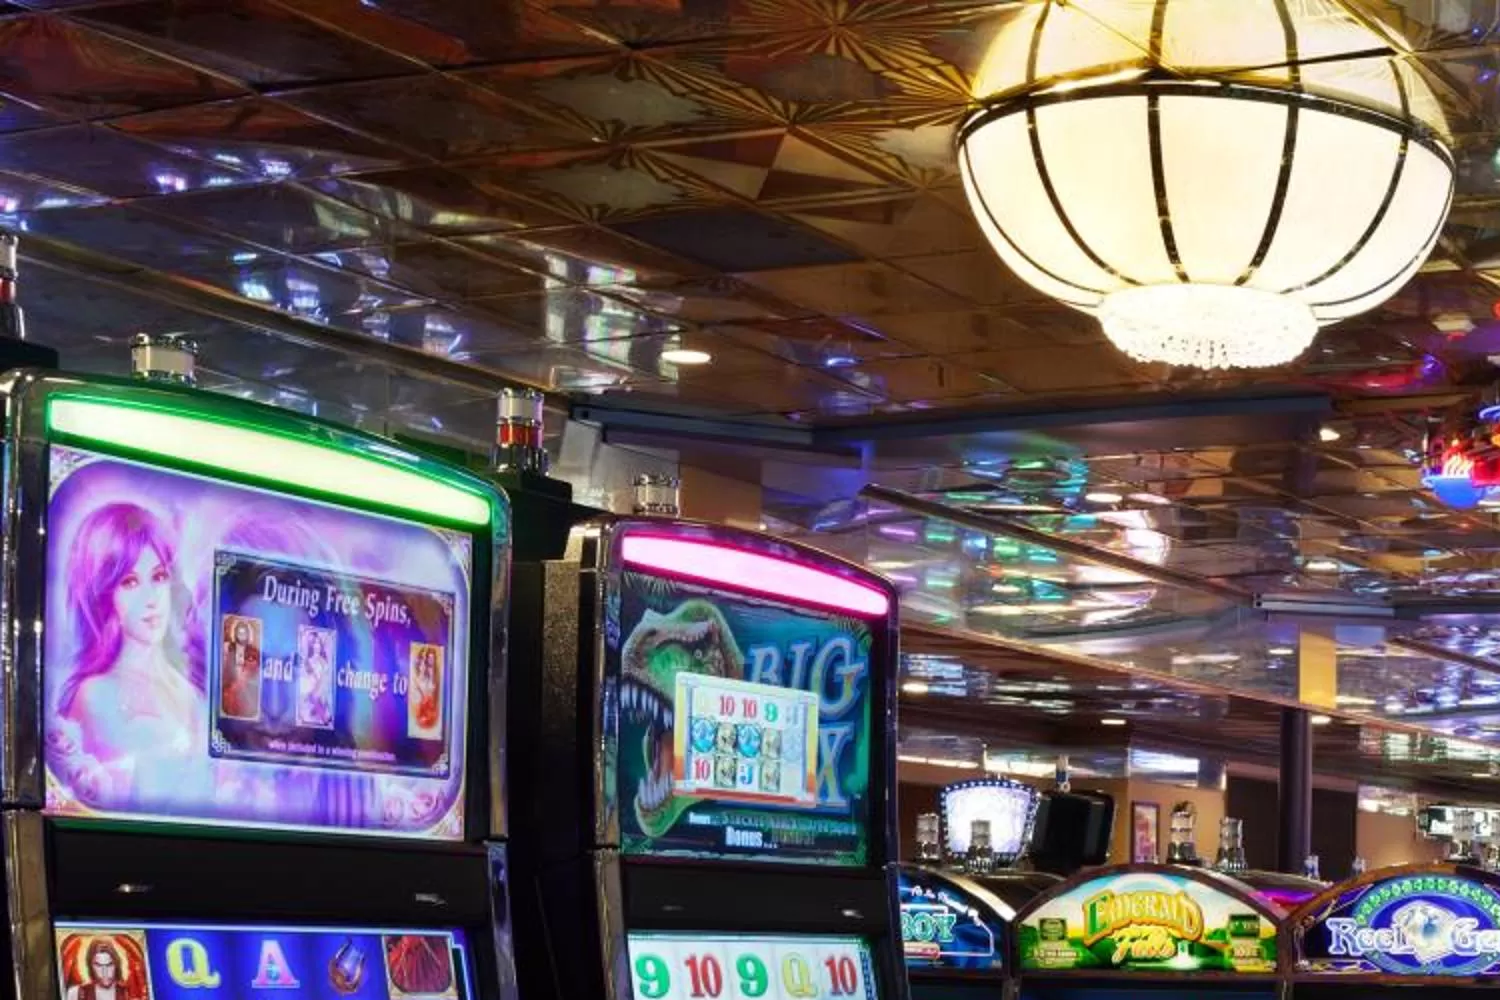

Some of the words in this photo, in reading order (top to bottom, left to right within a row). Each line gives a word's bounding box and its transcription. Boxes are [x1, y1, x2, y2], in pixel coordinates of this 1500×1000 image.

[263, 575, 320, 617] During
[325, 586, 360, 615] Free
[365, 593, 411, 627] Spins,
[263, 652, 294, 681] and
[337, 661, 387, 699] change
[393, 676, 408, 698] to
[750, 634, 866, 717] BIG
[166, 938, 220, 989] Q
[251, 939, 301, 988] A
[635, 953, 671, 999] 9
[684, 952, 723, 999] 10
[735, 953, 769, 998] 9
[782, 952, 818, 998] Q
[825, 955, 858, 996] 10
